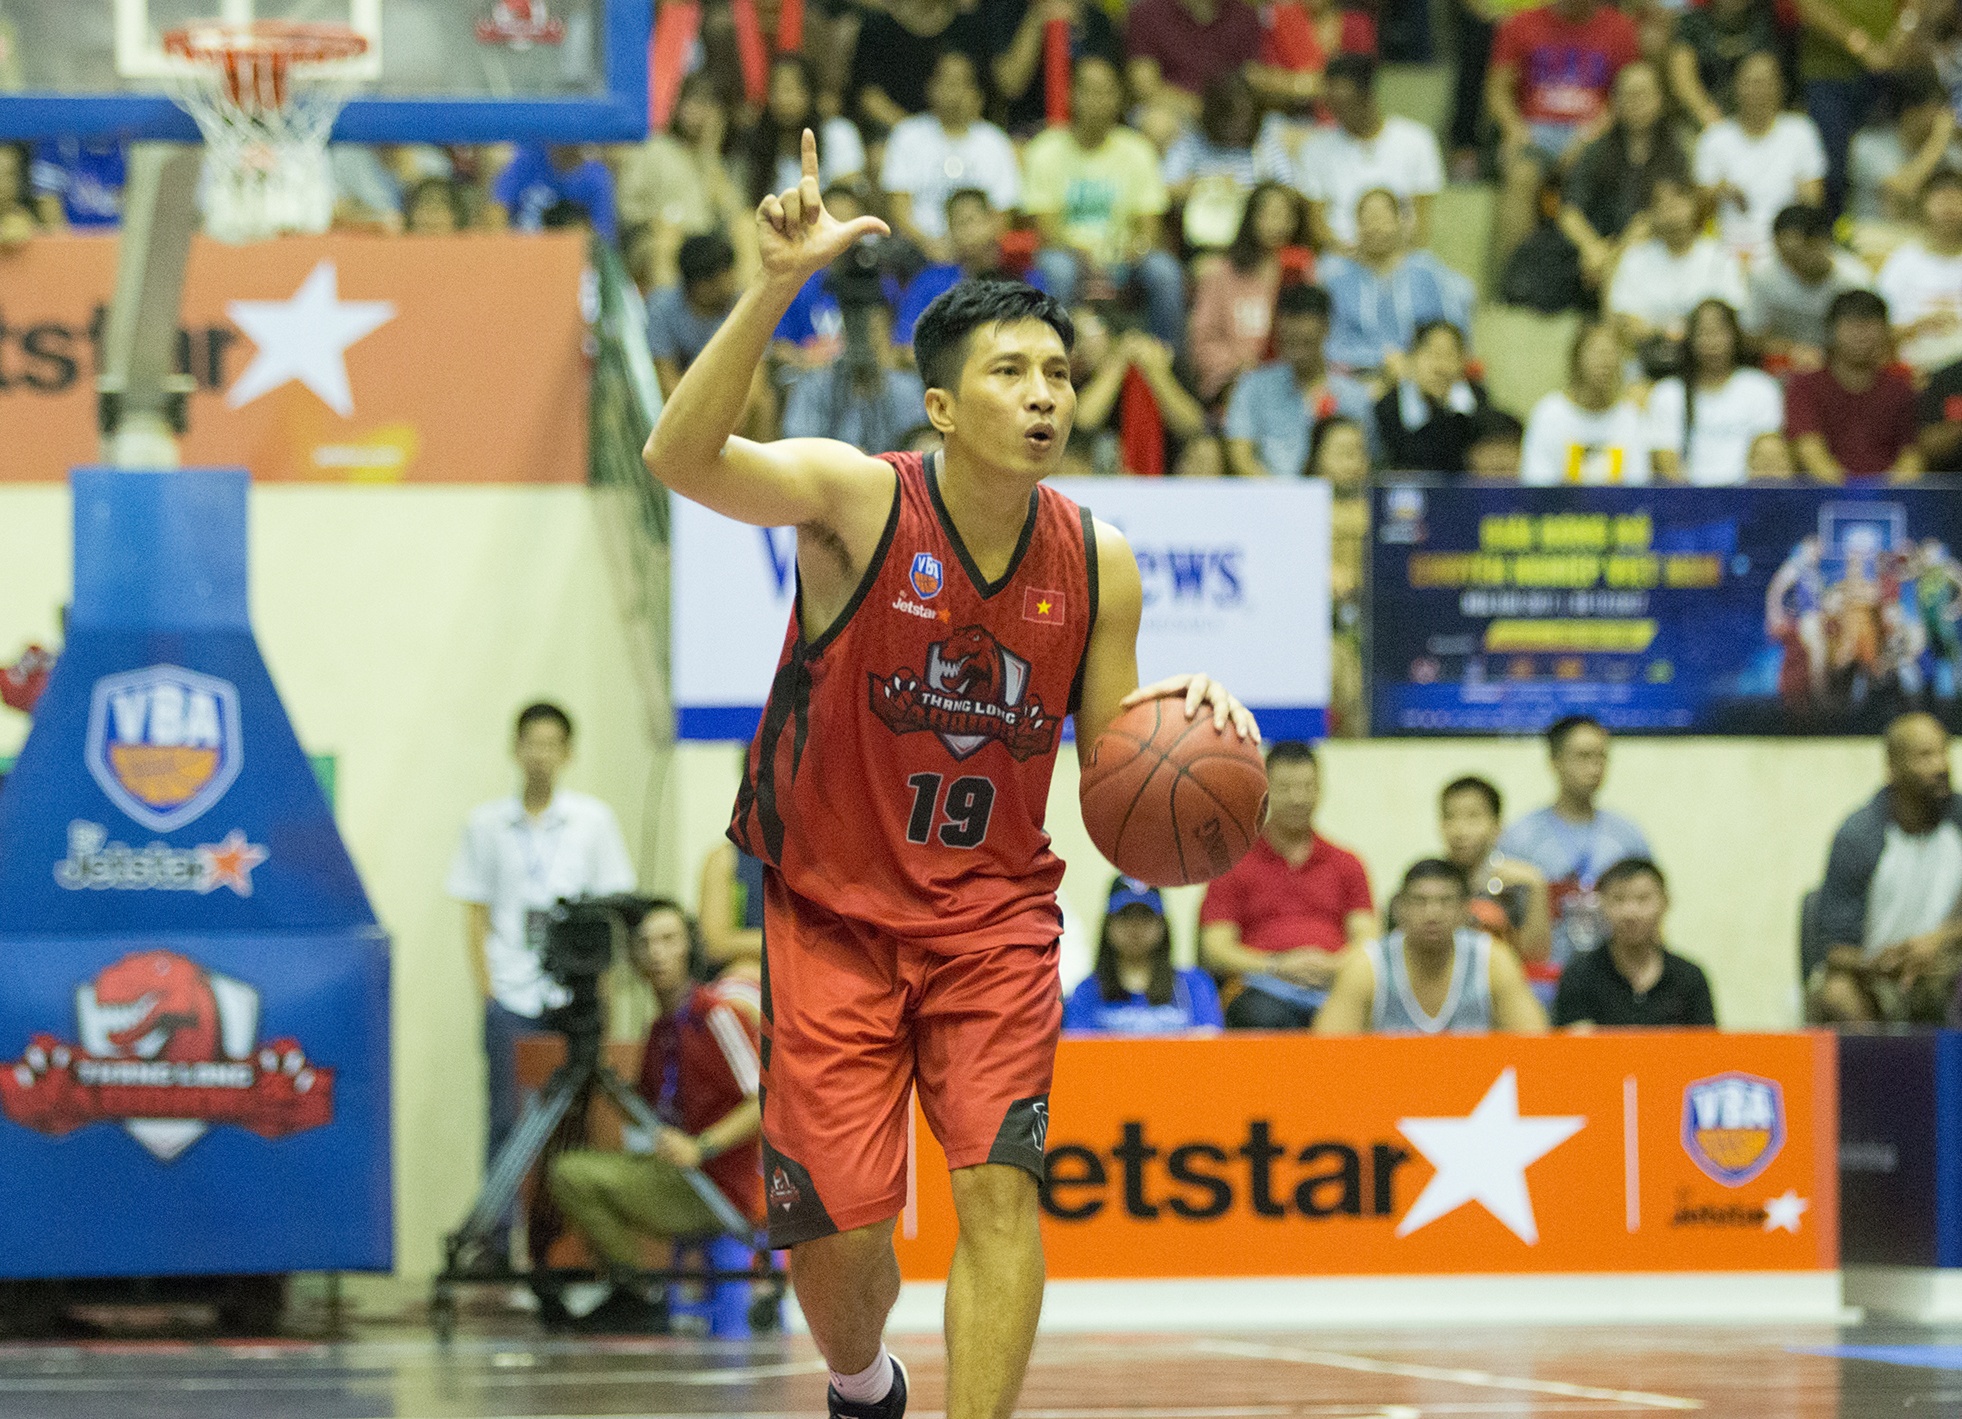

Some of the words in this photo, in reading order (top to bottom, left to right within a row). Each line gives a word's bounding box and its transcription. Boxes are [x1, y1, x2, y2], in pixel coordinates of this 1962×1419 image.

[1133, 548, 1243, 607] ews
[892, 598, 937, 619] Jetstar
[111, 684, 221, 746] VBA
[922, 692, 971, 712] THANG
[974, 701, 1016, 725] LONG
[906, 771, 997, 851] 19
[1038, 1119, 1412, 1222] etstar
